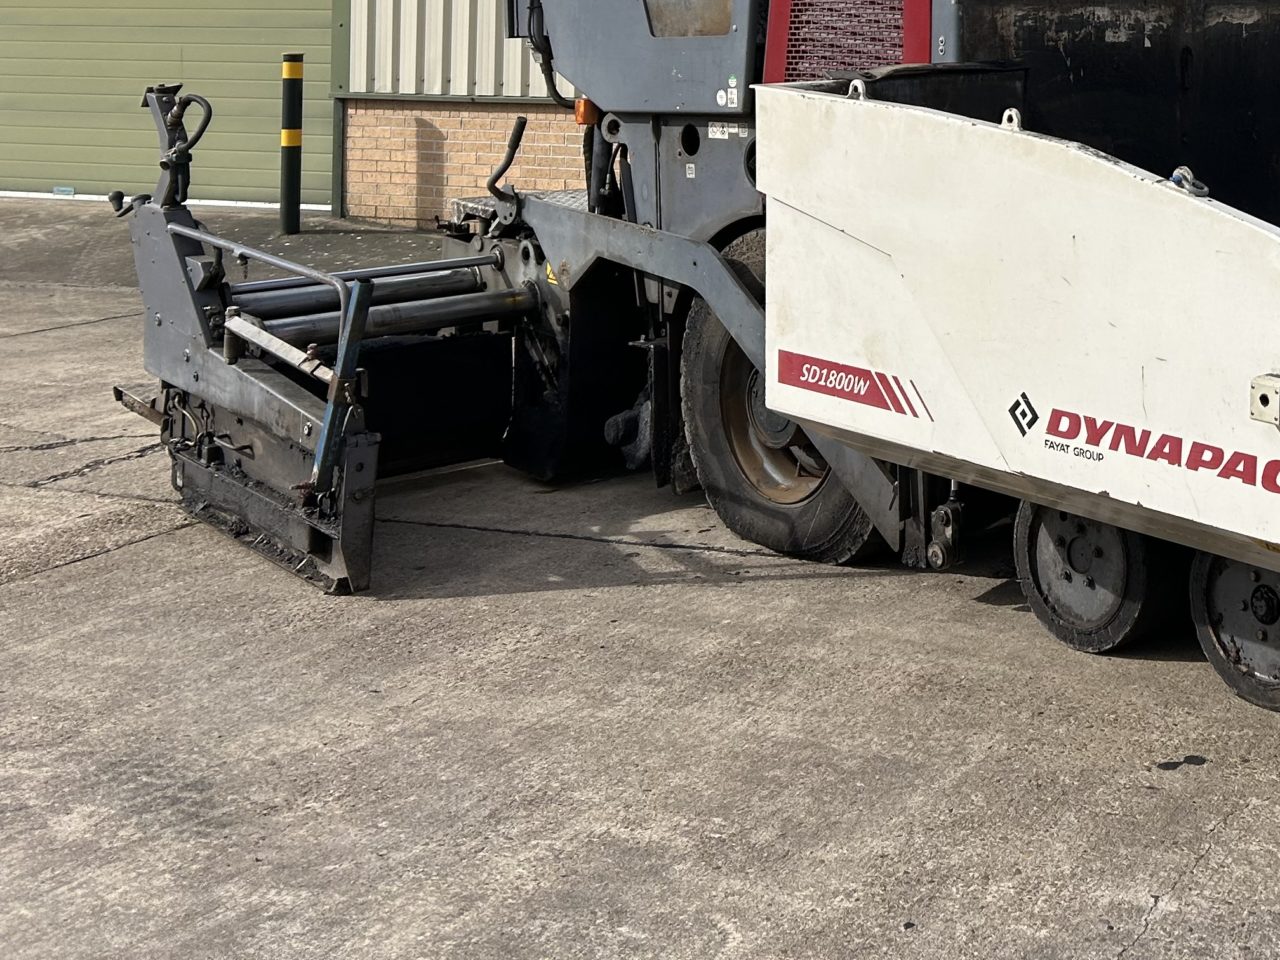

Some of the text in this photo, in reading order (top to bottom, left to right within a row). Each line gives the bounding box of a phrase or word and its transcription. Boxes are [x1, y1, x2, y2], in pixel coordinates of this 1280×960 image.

[799, 363, 871, 396] SD1800W
[1044, 438, 1105, 463] FAYAT GROUP
